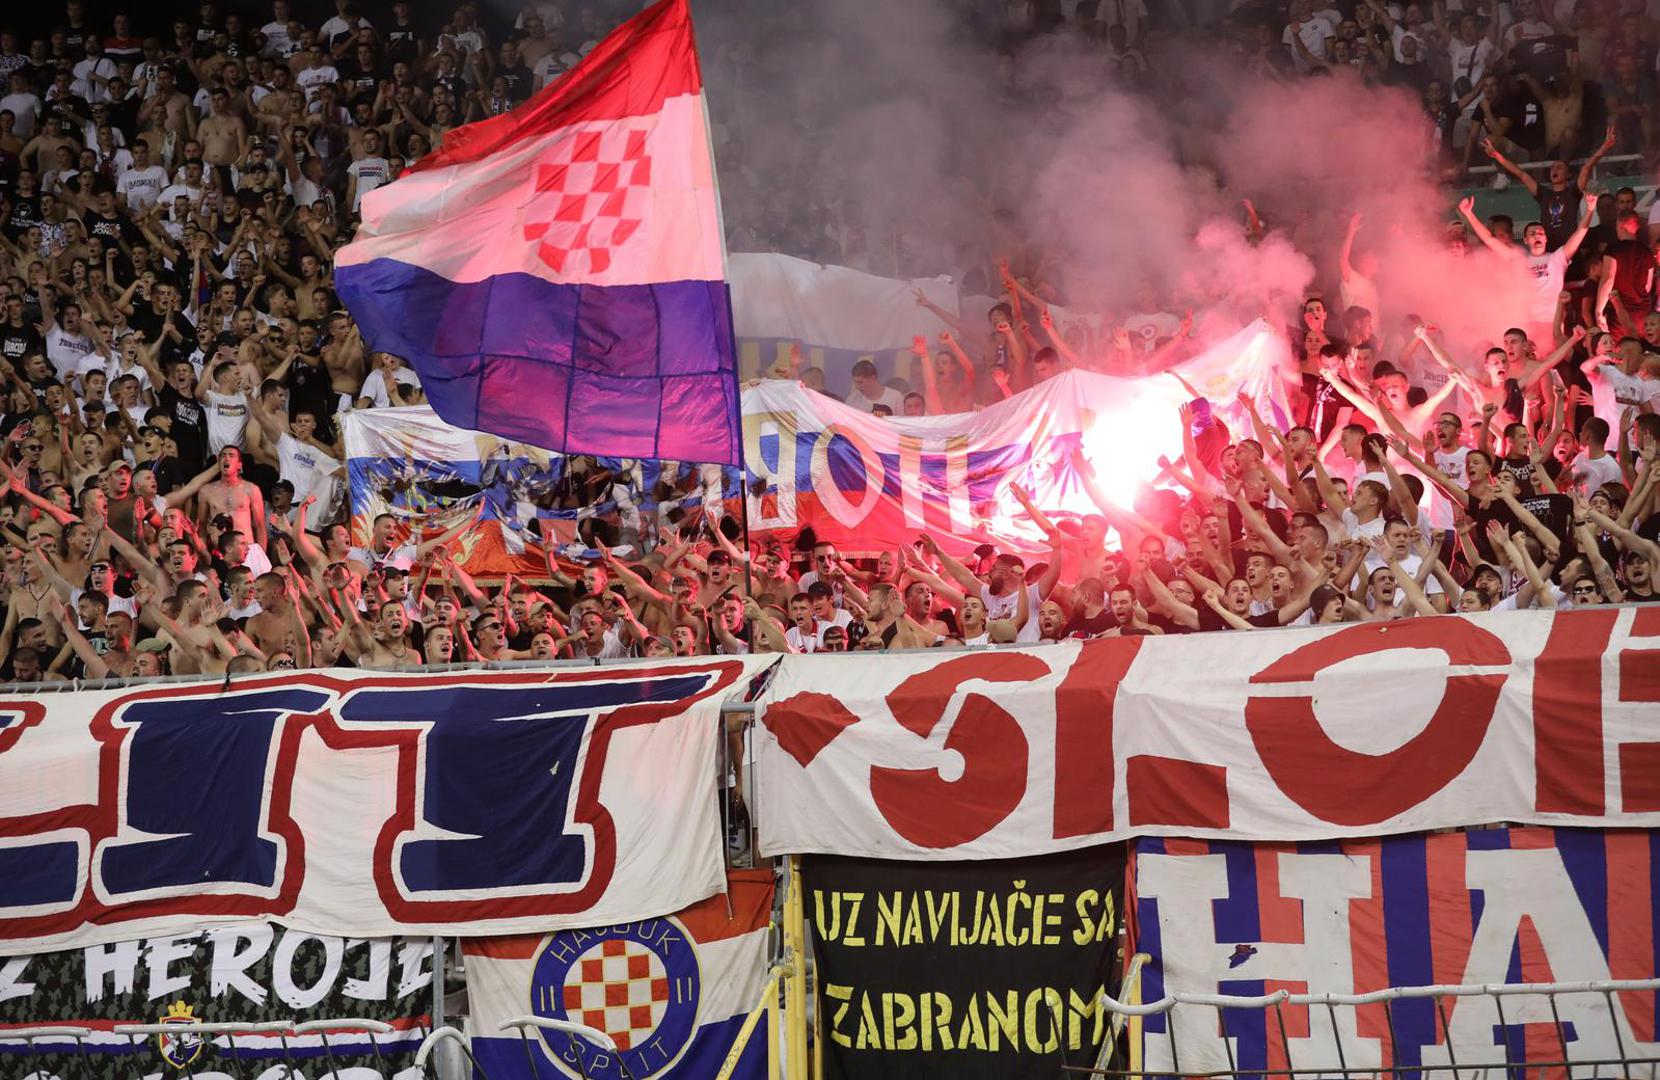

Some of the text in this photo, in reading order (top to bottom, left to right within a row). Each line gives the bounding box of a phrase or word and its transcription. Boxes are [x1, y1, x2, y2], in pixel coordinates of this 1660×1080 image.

[0, 662, 743, 938] IT
[814, 879, 1115, 948] UZ NAVIJAČE SA
[1137, 848, 1660, 1080] HA
[826, 983, 1106, 1054] ZABRANOM
